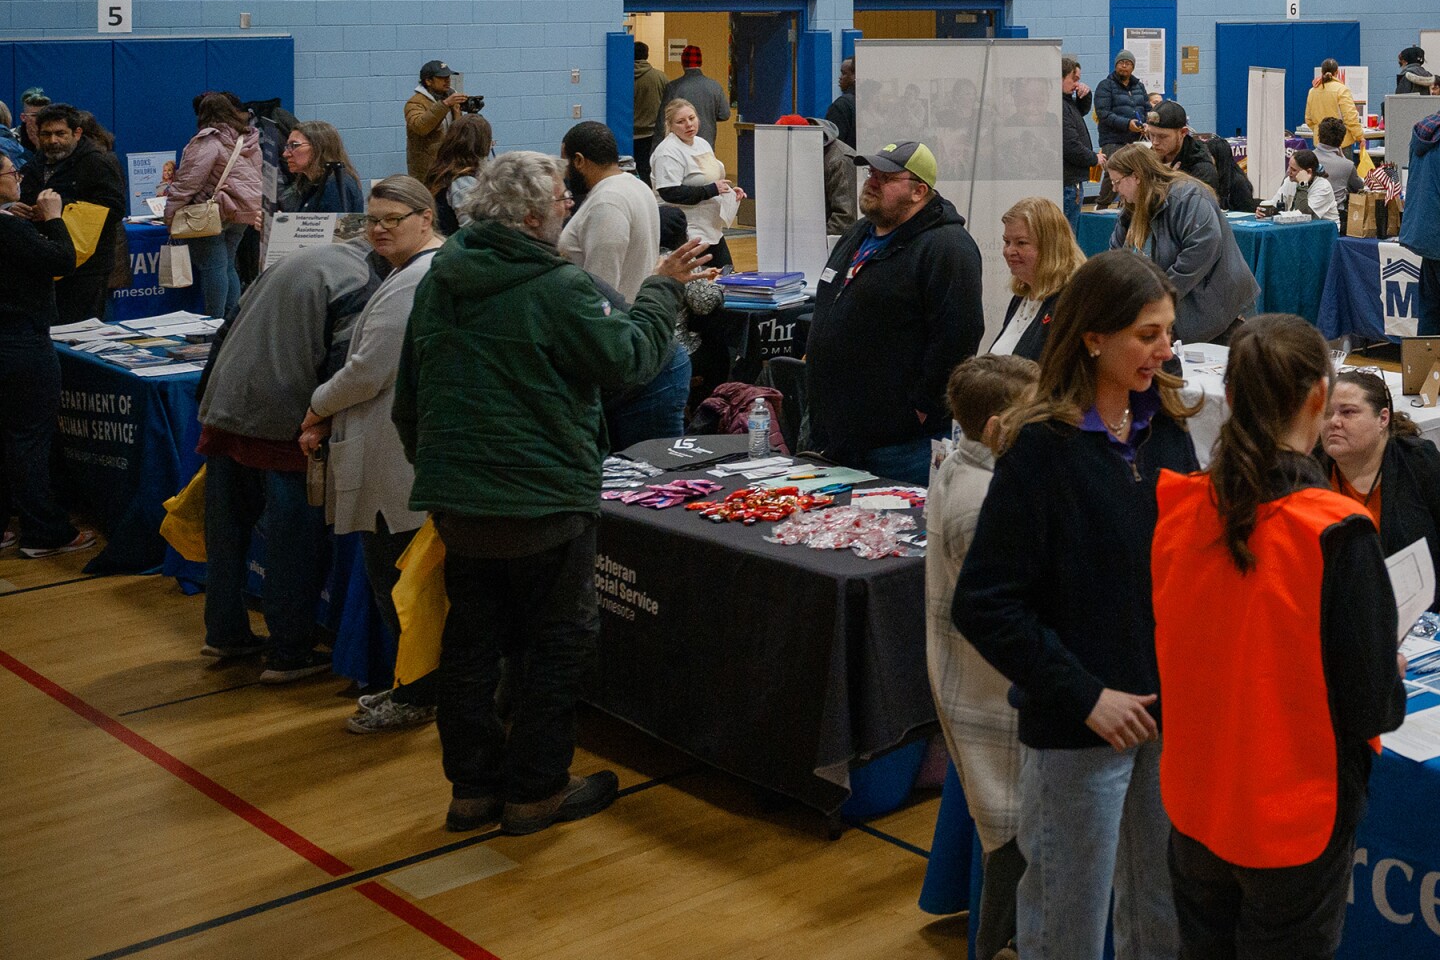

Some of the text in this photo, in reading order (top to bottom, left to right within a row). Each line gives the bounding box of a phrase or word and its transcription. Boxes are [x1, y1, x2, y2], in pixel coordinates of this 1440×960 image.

[108, 6, 123, 27] 5
[1290, 2, 1297, 16] 6
[133, 159, 151, 167] BOOKS
[118, 394, 133, 416] OF
[619, 581, 659, 616] Service
